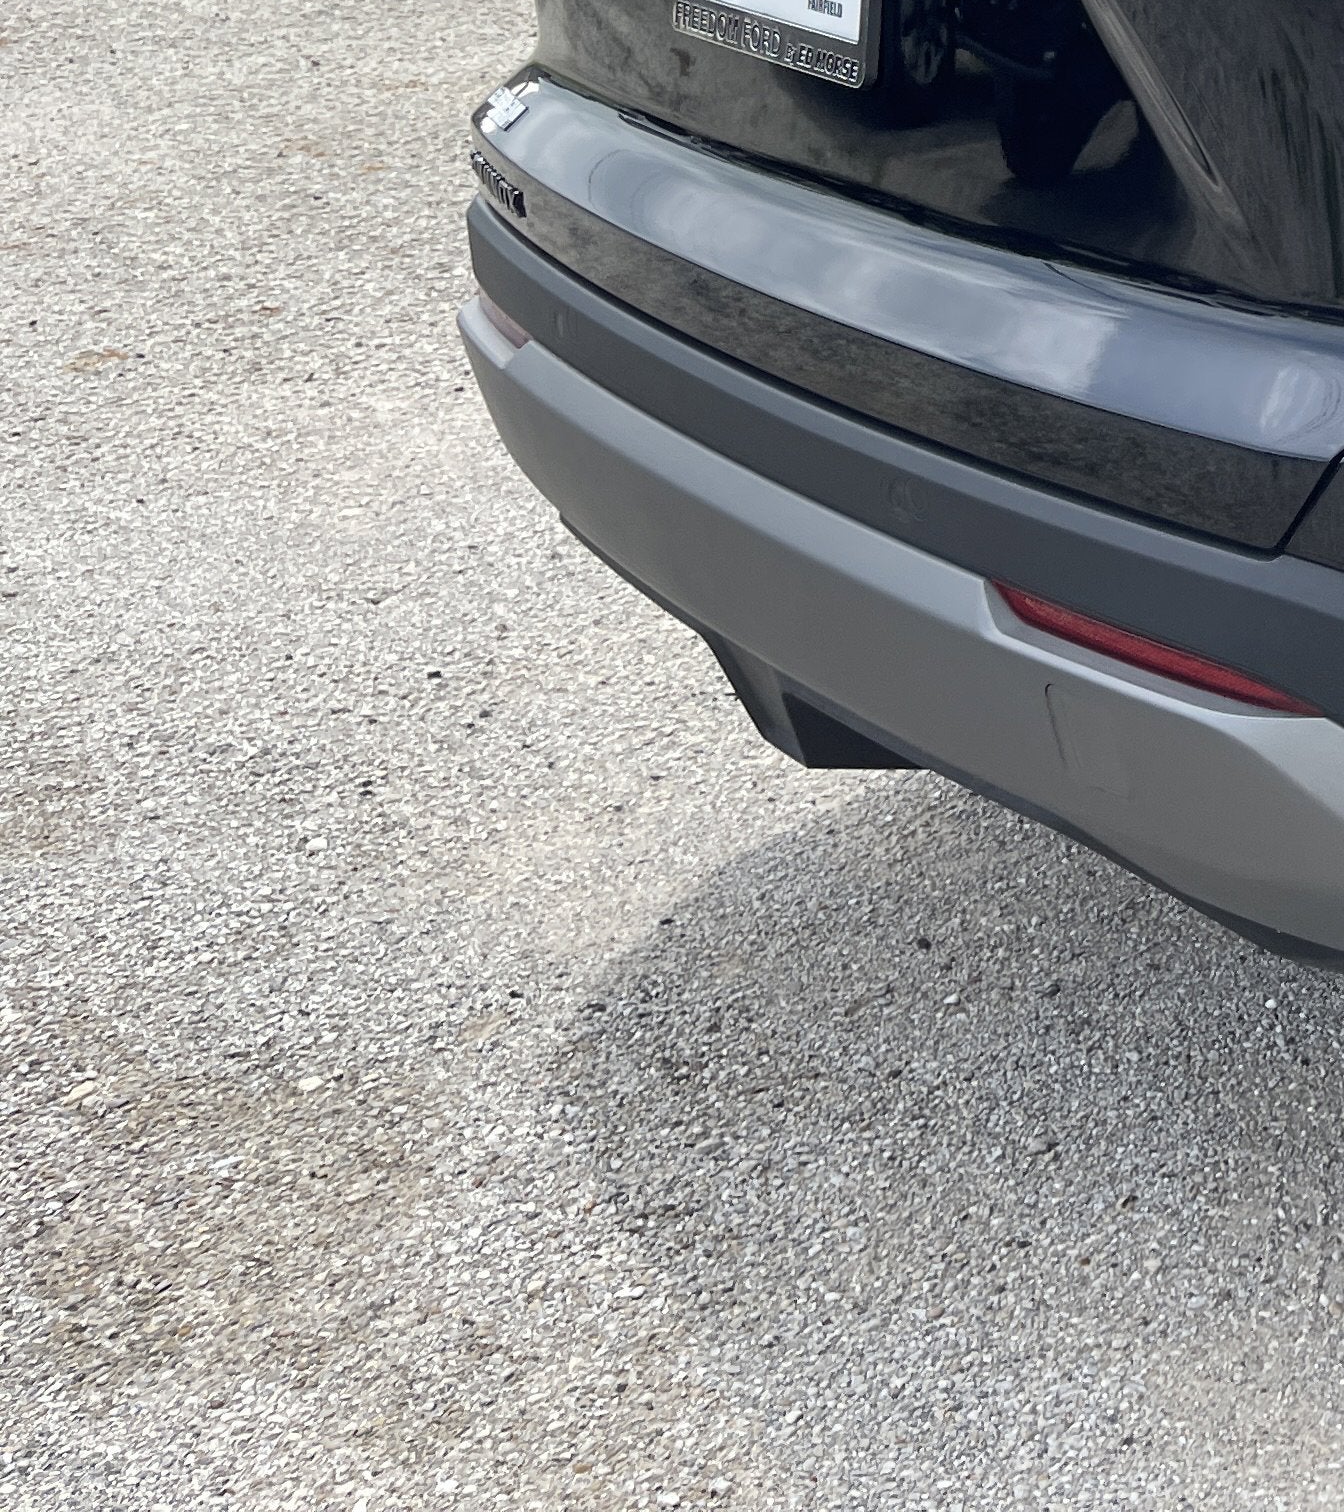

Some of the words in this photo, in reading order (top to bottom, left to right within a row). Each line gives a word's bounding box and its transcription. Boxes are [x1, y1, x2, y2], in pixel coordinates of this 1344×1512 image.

[675, 0, 740, 45] FREEDOM
[740, 17, 782, 58] FORD
[796, 42, 814, 69] ED
[813, 48, 859, 82] MORSE
